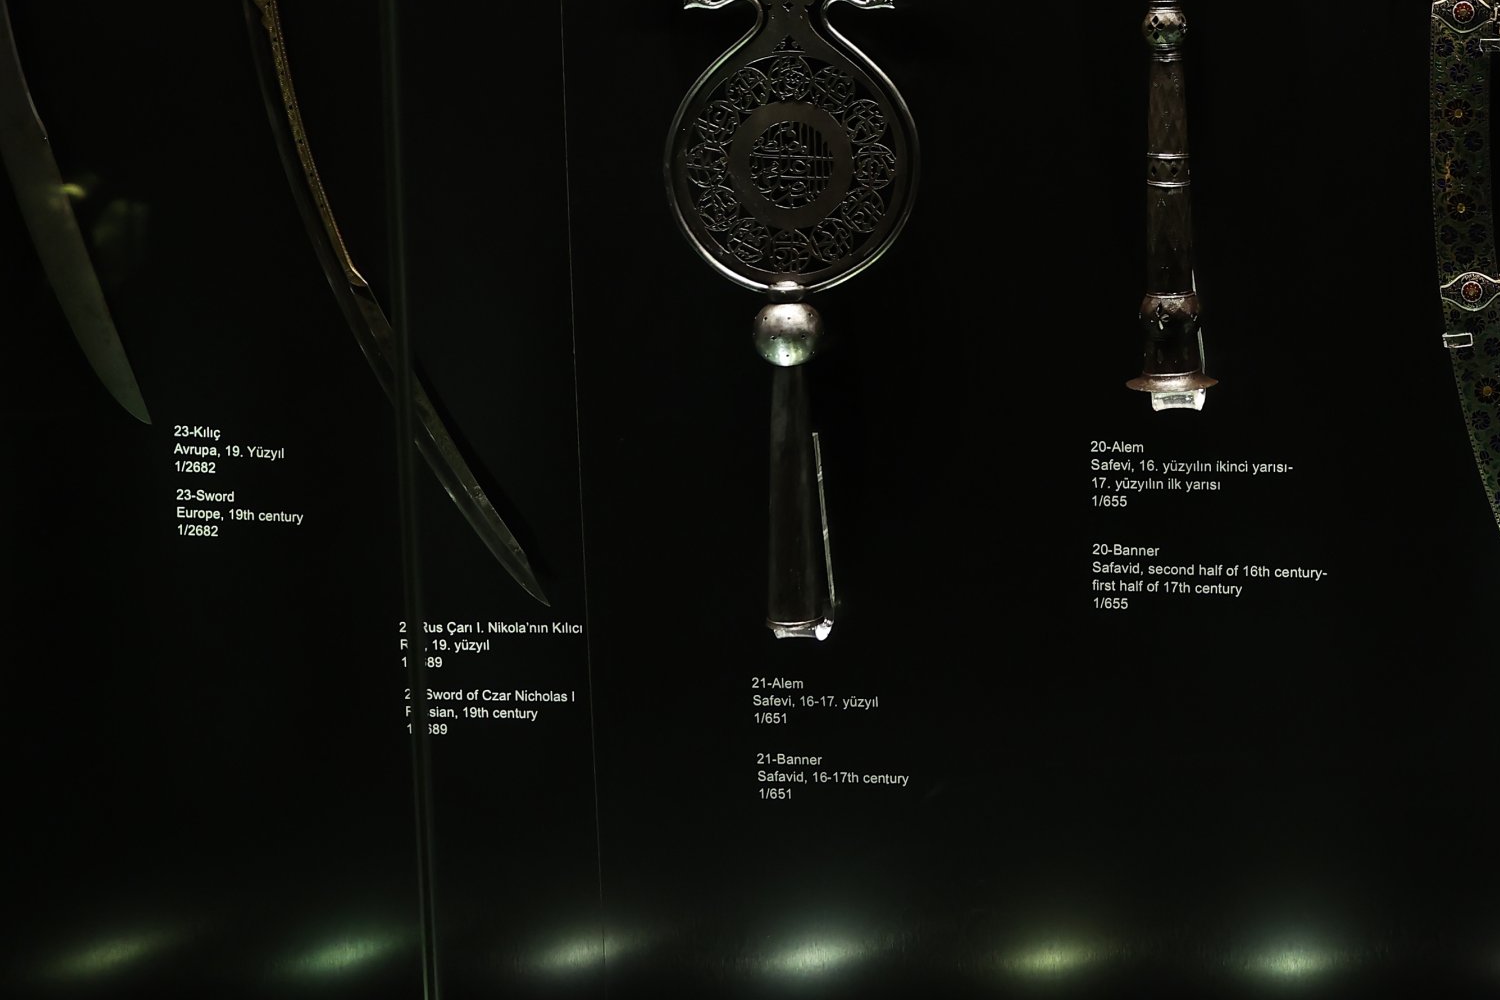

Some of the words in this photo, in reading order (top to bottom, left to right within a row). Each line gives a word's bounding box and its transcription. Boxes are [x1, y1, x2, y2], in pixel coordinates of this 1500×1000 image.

[173, 442, 221, 458] Avrupa,
[225, 445, 243, 458] 19.
[1090, 440, 1144, 453] 20-Alem
[175, 460, 216, 474] 1/2682
[1091, 458, 1134, 473] Safevi,
[1139, 459, 1158, 472] 16.
[1216, 460, 1248, 473] ikinci
[1092, 477, 1111, 489] 17.
[176, 488, 235, 502] 23-Sword
[1092, 495, 1127, 507] 1/655
[176, 506, 224, 522] Europe,
[229, 508, 255, 521] 19th
[258, 511, 304, 526] century
[177, 524, 219, 537] 1/2682
[1092, 543, 1160, 557] 20-Banner
[1092, 561, 1144, 576] Safavid,
[1148, 564, 1194, 576] second
[1199, 564, 1223, 576] half
[1226, 564, 1239, 577] of
[1243, 565, 1270, 577] 16th
[1274, 567, 1328, 581] century-
[1092, 579, 1116, 591] first
[1119, 580, 1144, 592] half
[1163, 581, 1191, 593] 17th
[1195, 583, 1243, 598] century
[1093, 597, 1129, 610] 1/655
[432, 639, 451, 651] 19.
[751, 677, 804, 689] 21-Alem
[482, 689, 512, 701] Czar
[515, 689, 568, 702] Nicholas
[753, 694, 795, 708] Safevi,
[800, 695, 837, 707] 16-17.
[463, 706, 489, 718] 19th
[492, 708, 538, 722] century
[754, 712, 787, 724] 1/651
[757, 753, 822, 765] 21-Banner
[758, 770, 807, 784] Safavid,
[813, 771, 859, 783] 16-17th
[863, 774, 909, 787] century
[759, 788, 791, 800] 1/651
